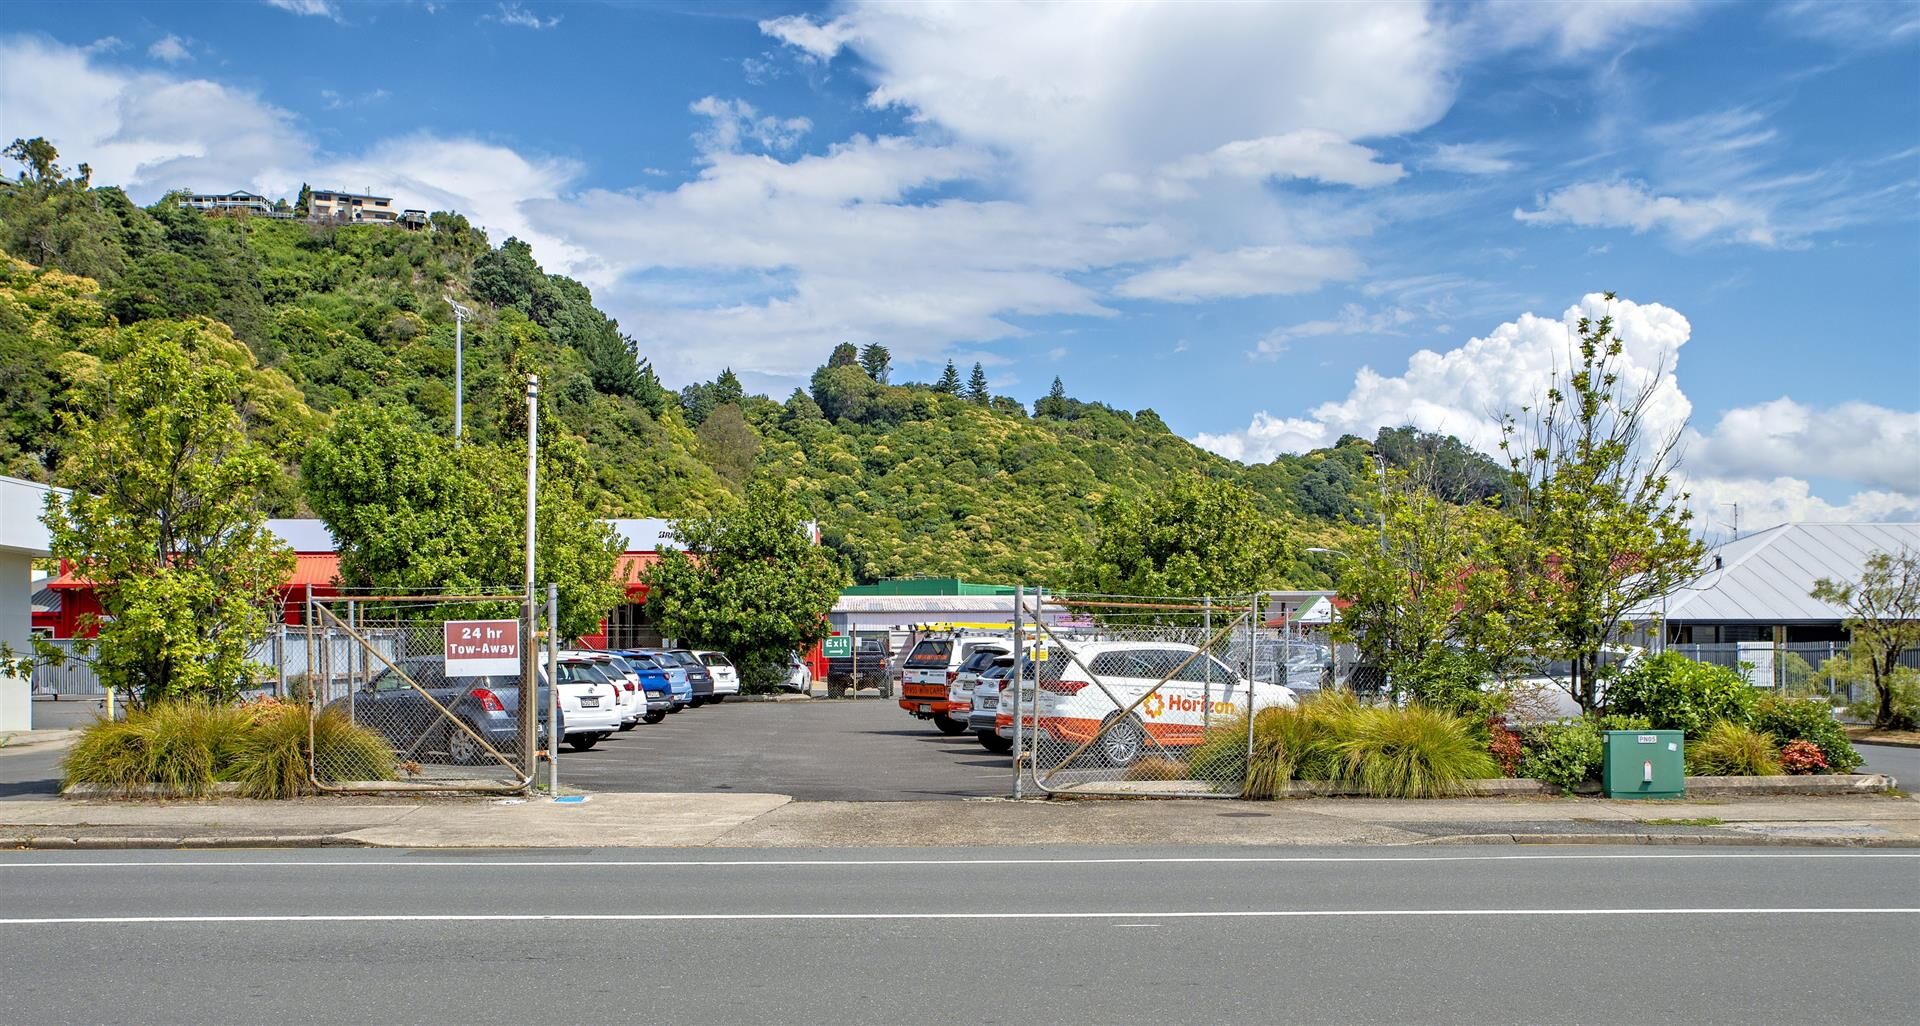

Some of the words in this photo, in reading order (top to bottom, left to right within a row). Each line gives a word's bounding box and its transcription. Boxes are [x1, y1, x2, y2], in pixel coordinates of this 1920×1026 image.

[462, 627, 481, 639] 24
[486, 627, 503, 639] hr
[825, 638, 848, 648] Exit
[449, 643, 515, 656] Tow-Away
[1169, 694, 1235, 714] Horizon
